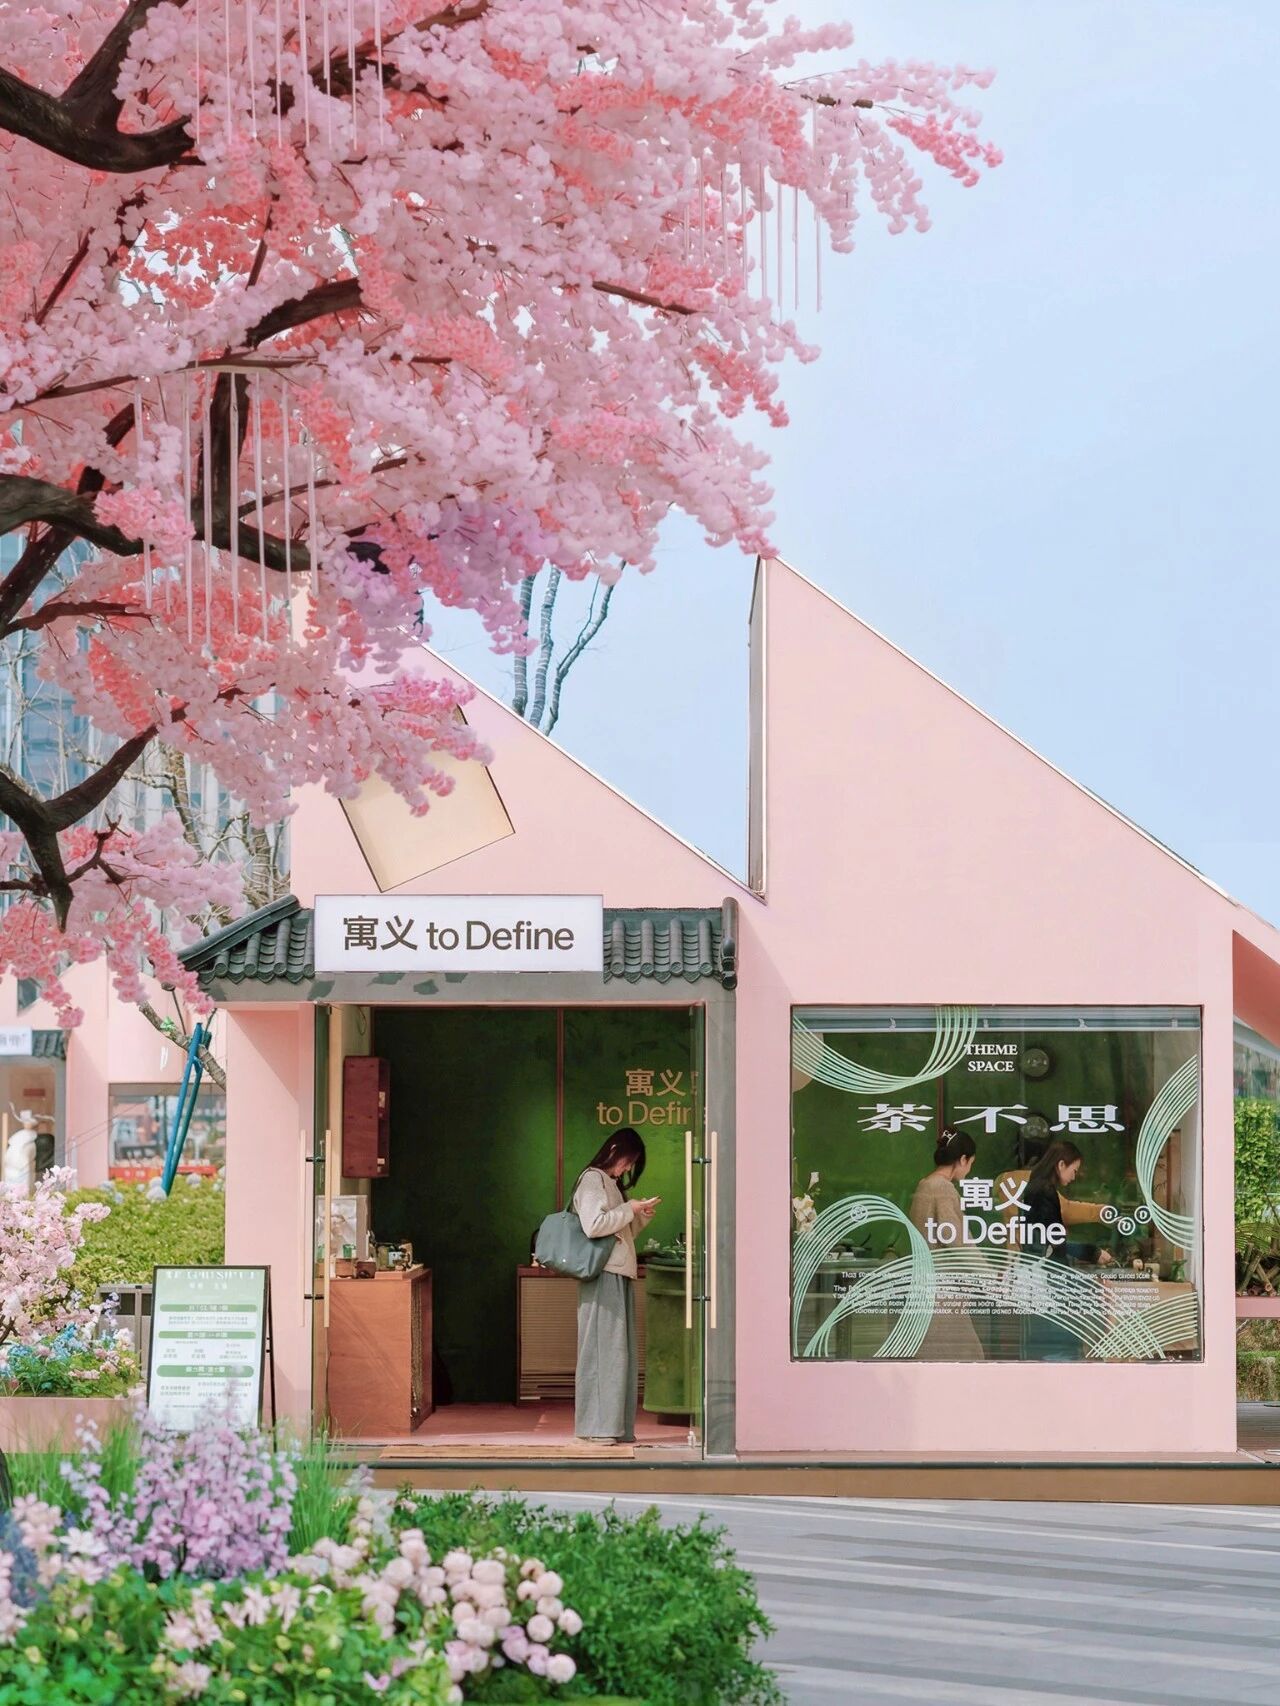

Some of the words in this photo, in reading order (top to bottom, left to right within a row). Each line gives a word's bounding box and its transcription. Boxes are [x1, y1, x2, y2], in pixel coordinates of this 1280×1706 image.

[343, 916, 418, 951] 寓义
[426, 922, 459, 950] to
[466, 921, 574, 951] Define
[964, 1044, 1018, 1055] THEME
[968, 1060, 1015, 1073] SPACE
[625, 1069, 686, 1097] 寓义
[597, 1102, 623, 1124] to
[857, 1104, 1125, 1133] 茶不思
[959, 1177, 1031, 1212] 寓义
[925, 1220, 956, 1245] to
[963, 1216, 1066, 1245] Define
